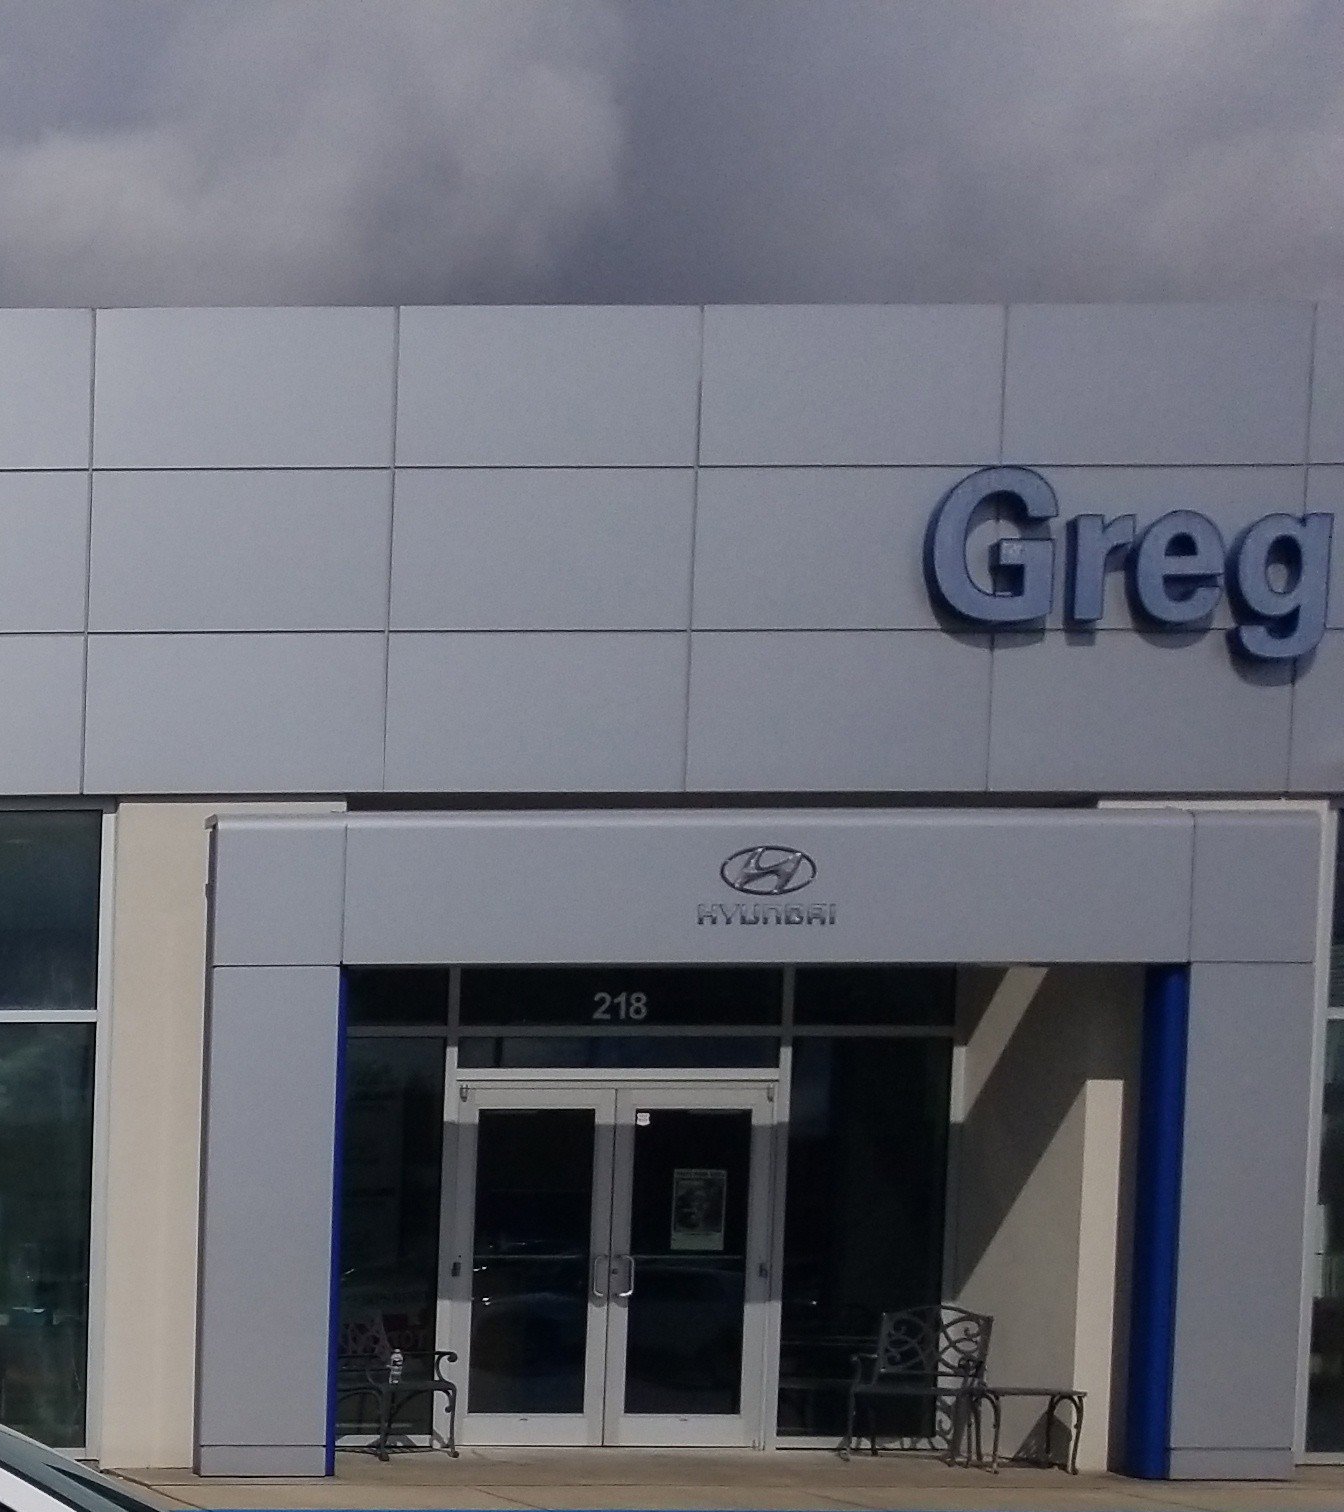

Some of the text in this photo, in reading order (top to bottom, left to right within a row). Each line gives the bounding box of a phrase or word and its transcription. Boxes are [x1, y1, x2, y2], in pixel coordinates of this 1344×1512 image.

[926, 465, 1334, 660] Greg
[696, 902, 838, 926] HYUNDAI
[592, 991, 648, 1020] 218
